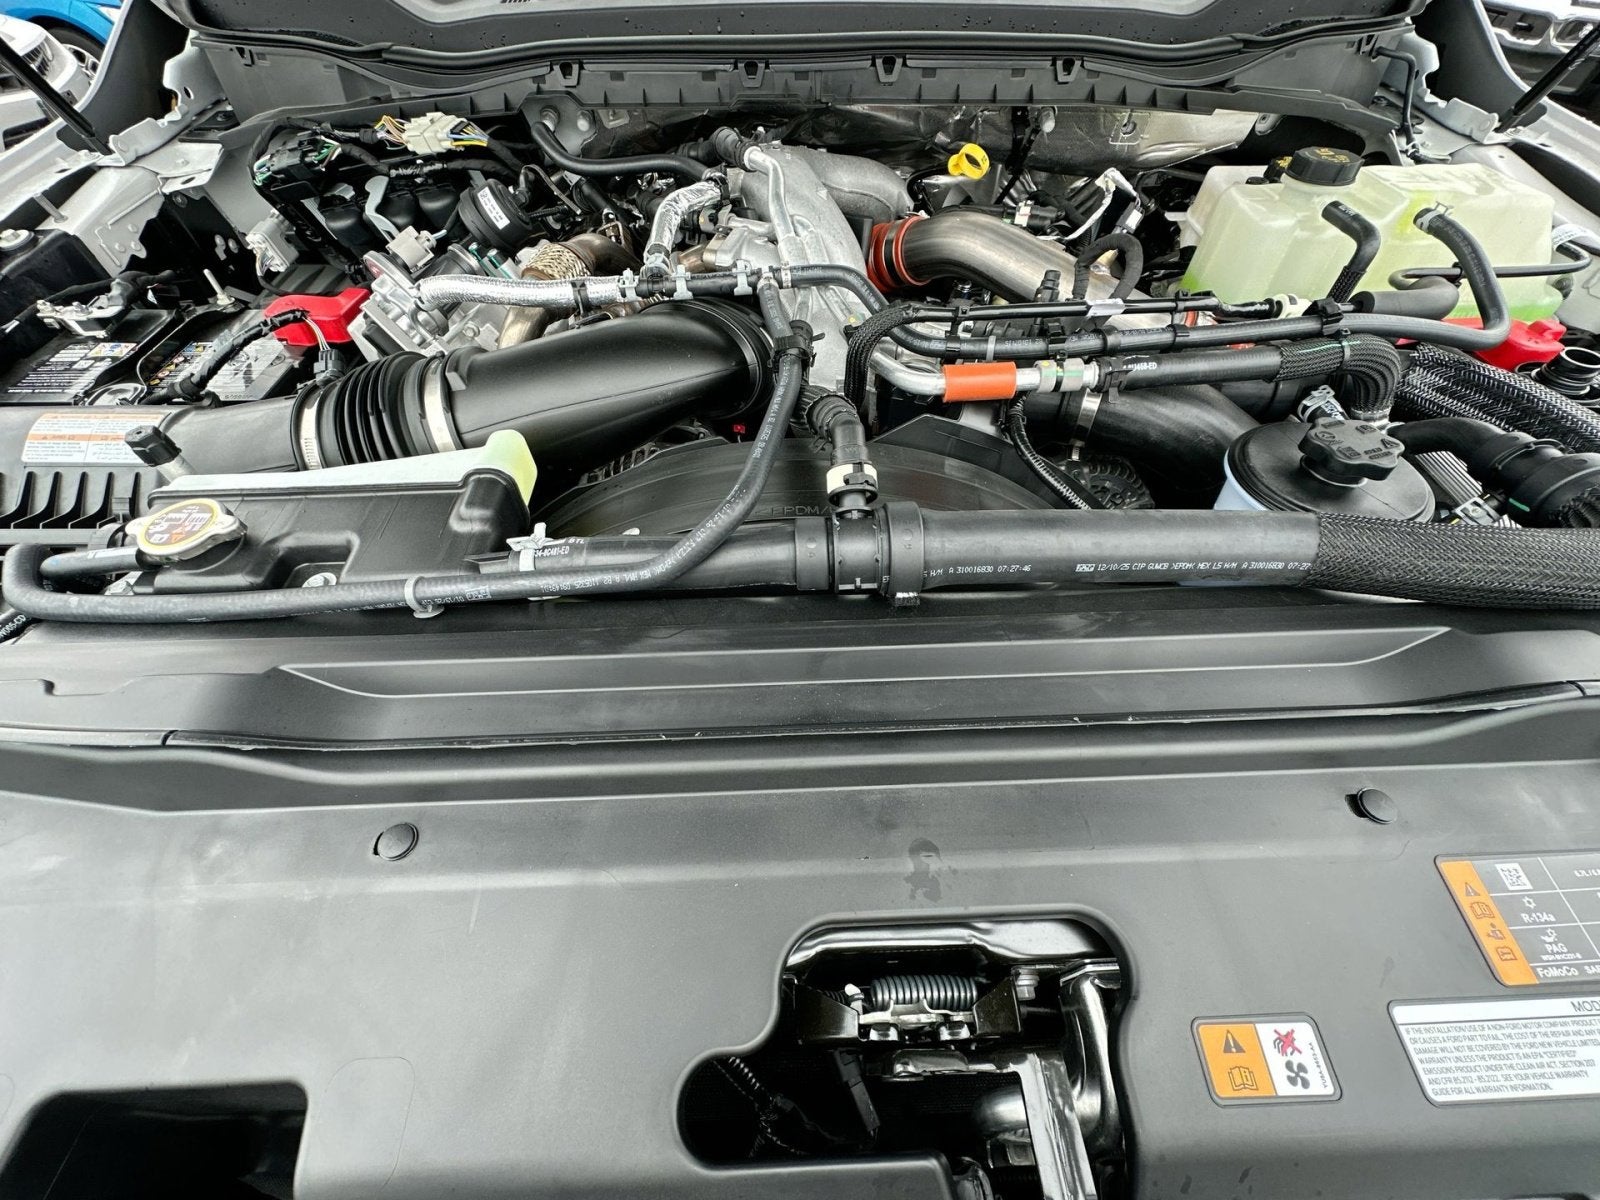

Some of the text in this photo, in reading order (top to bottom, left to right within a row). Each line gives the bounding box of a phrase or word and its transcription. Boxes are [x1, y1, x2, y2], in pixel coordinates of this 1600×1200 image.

[1520, 911, 1556, 924] R-134a
[1545, 942, 1568, 954] PAG
[1535, 965, 1580, 979] FoMoCo
[1570, 1000, 1600, 1012] MOD
